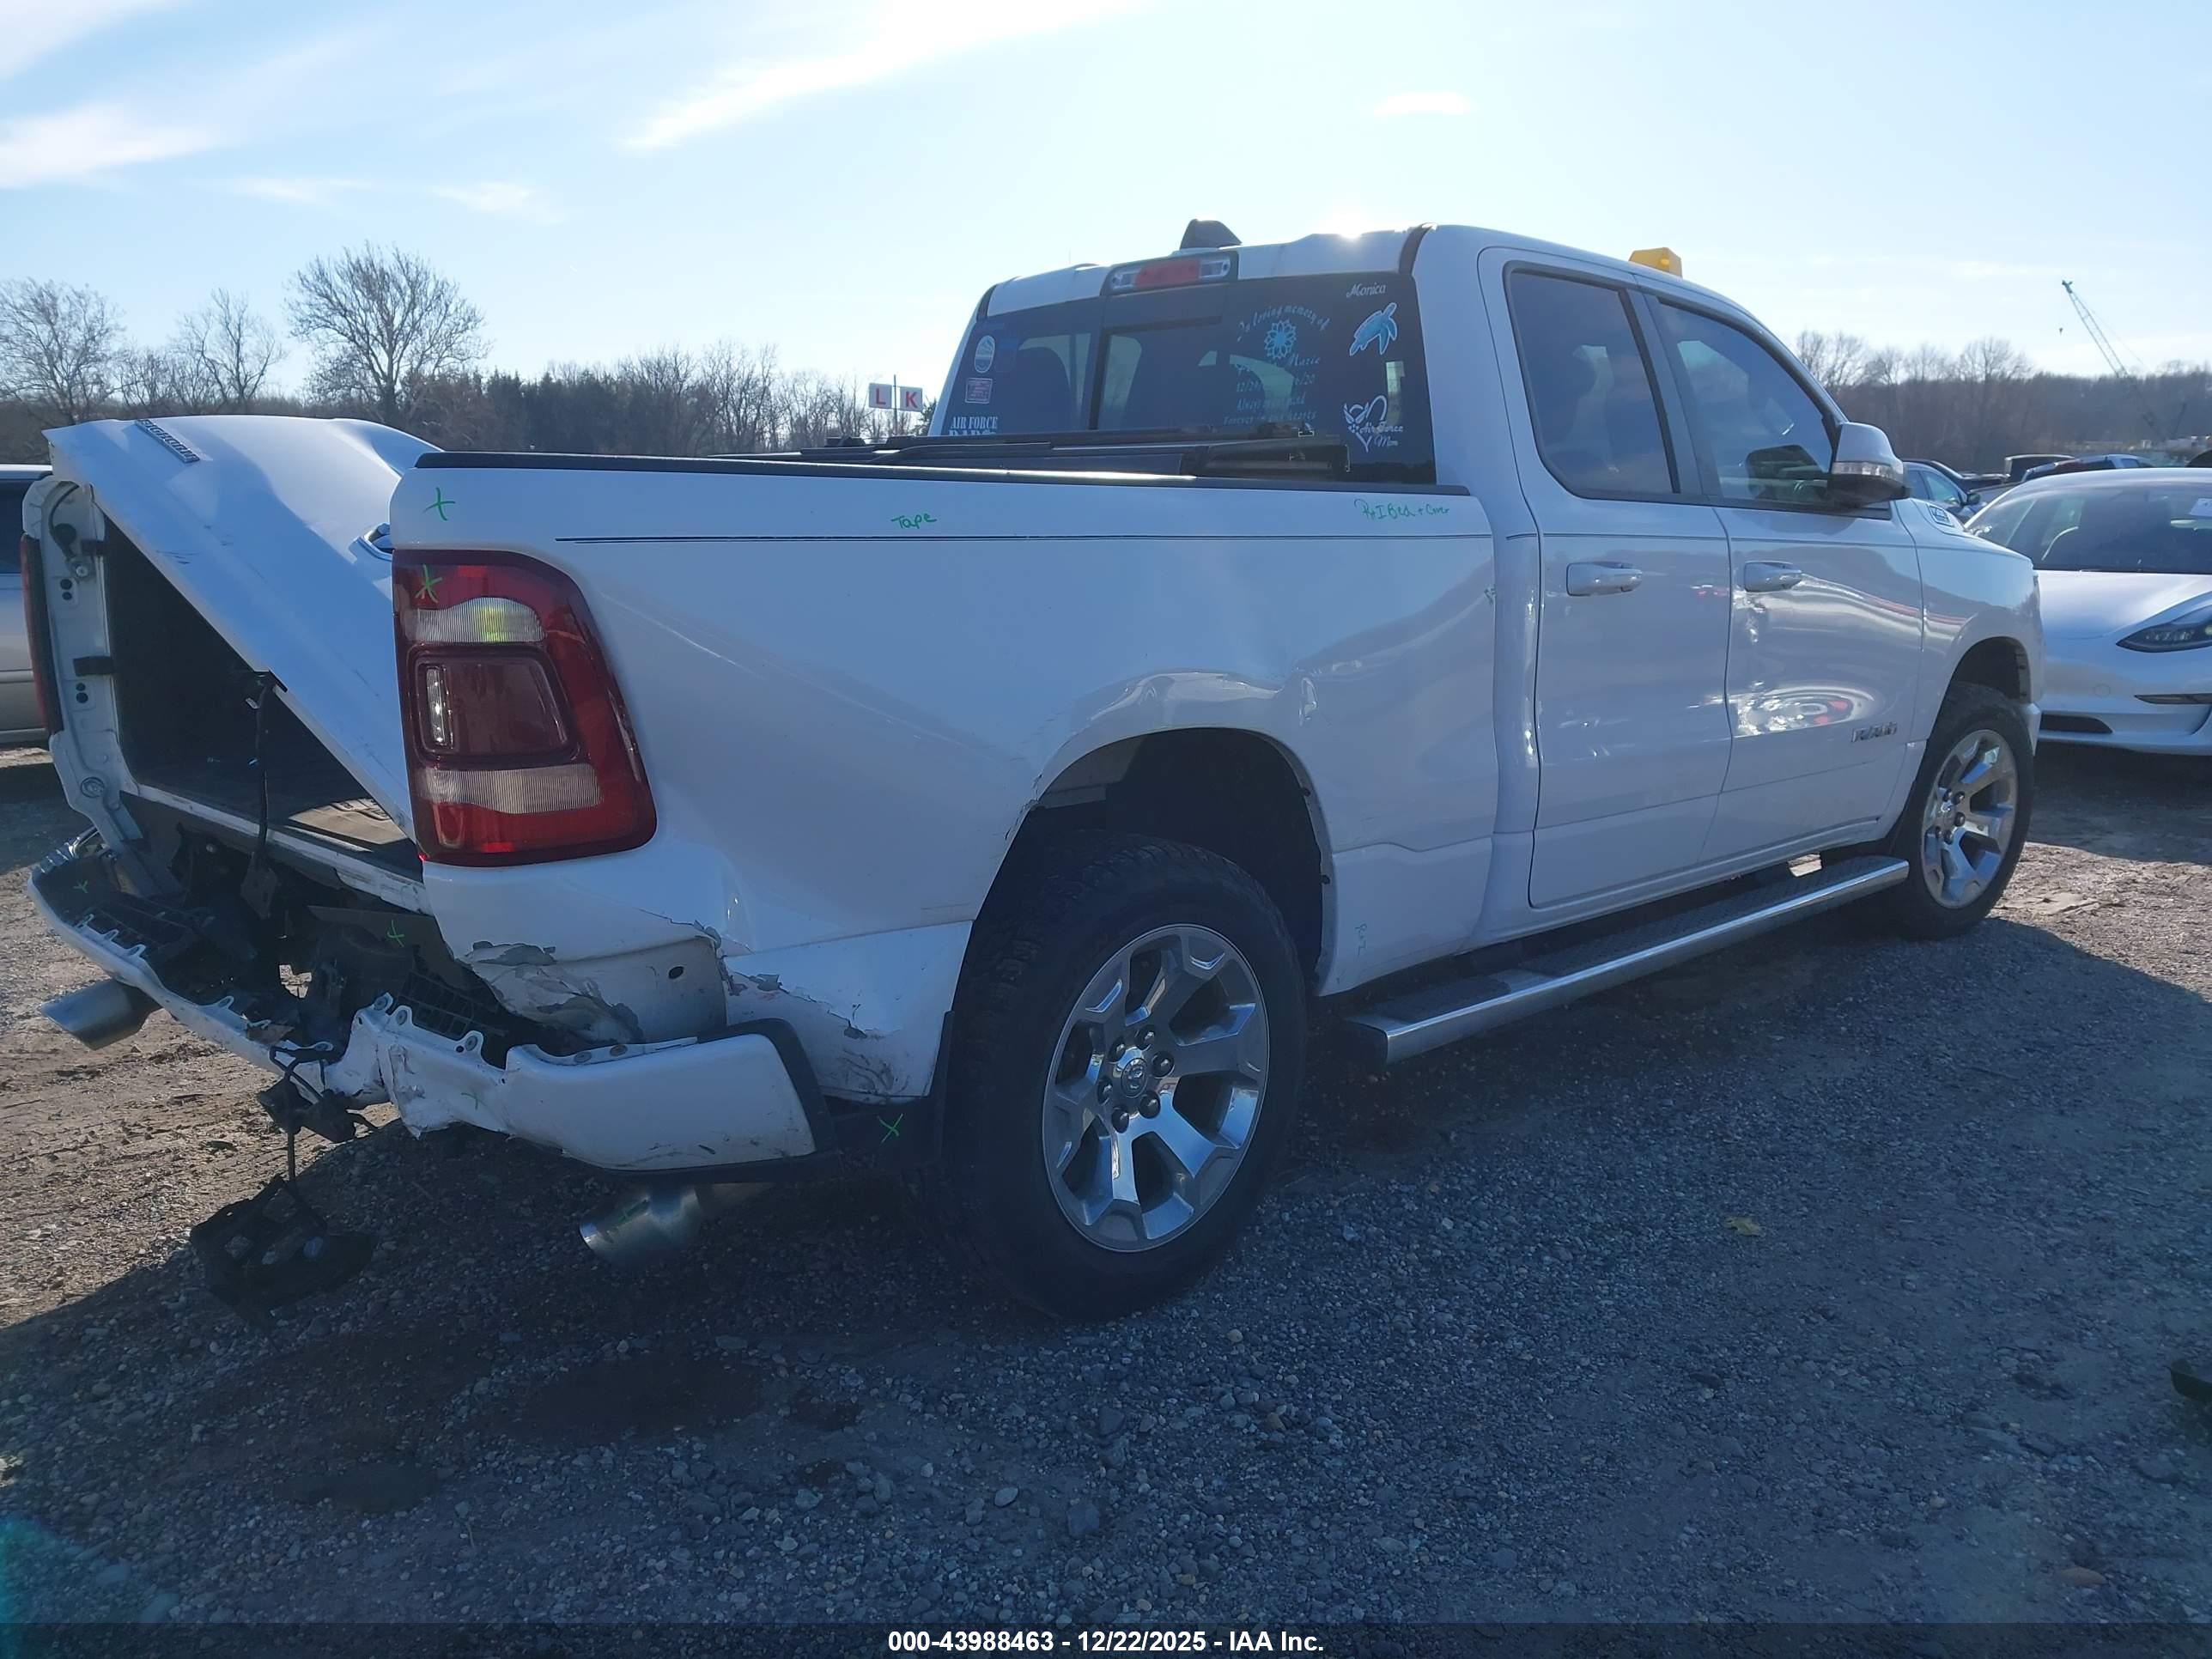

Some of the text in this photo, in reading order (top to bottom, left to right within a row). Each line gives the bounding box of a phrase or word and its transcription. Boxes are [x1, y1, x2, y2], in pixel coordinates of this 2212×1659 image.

[1346, 282, 1387, 298] Monica
[876, 387, 886, 405] L
[906, 391, 918, 409] K
[951, 416, 998, 429] AIR FORCE
[890, 513, 937, 529] Tape
